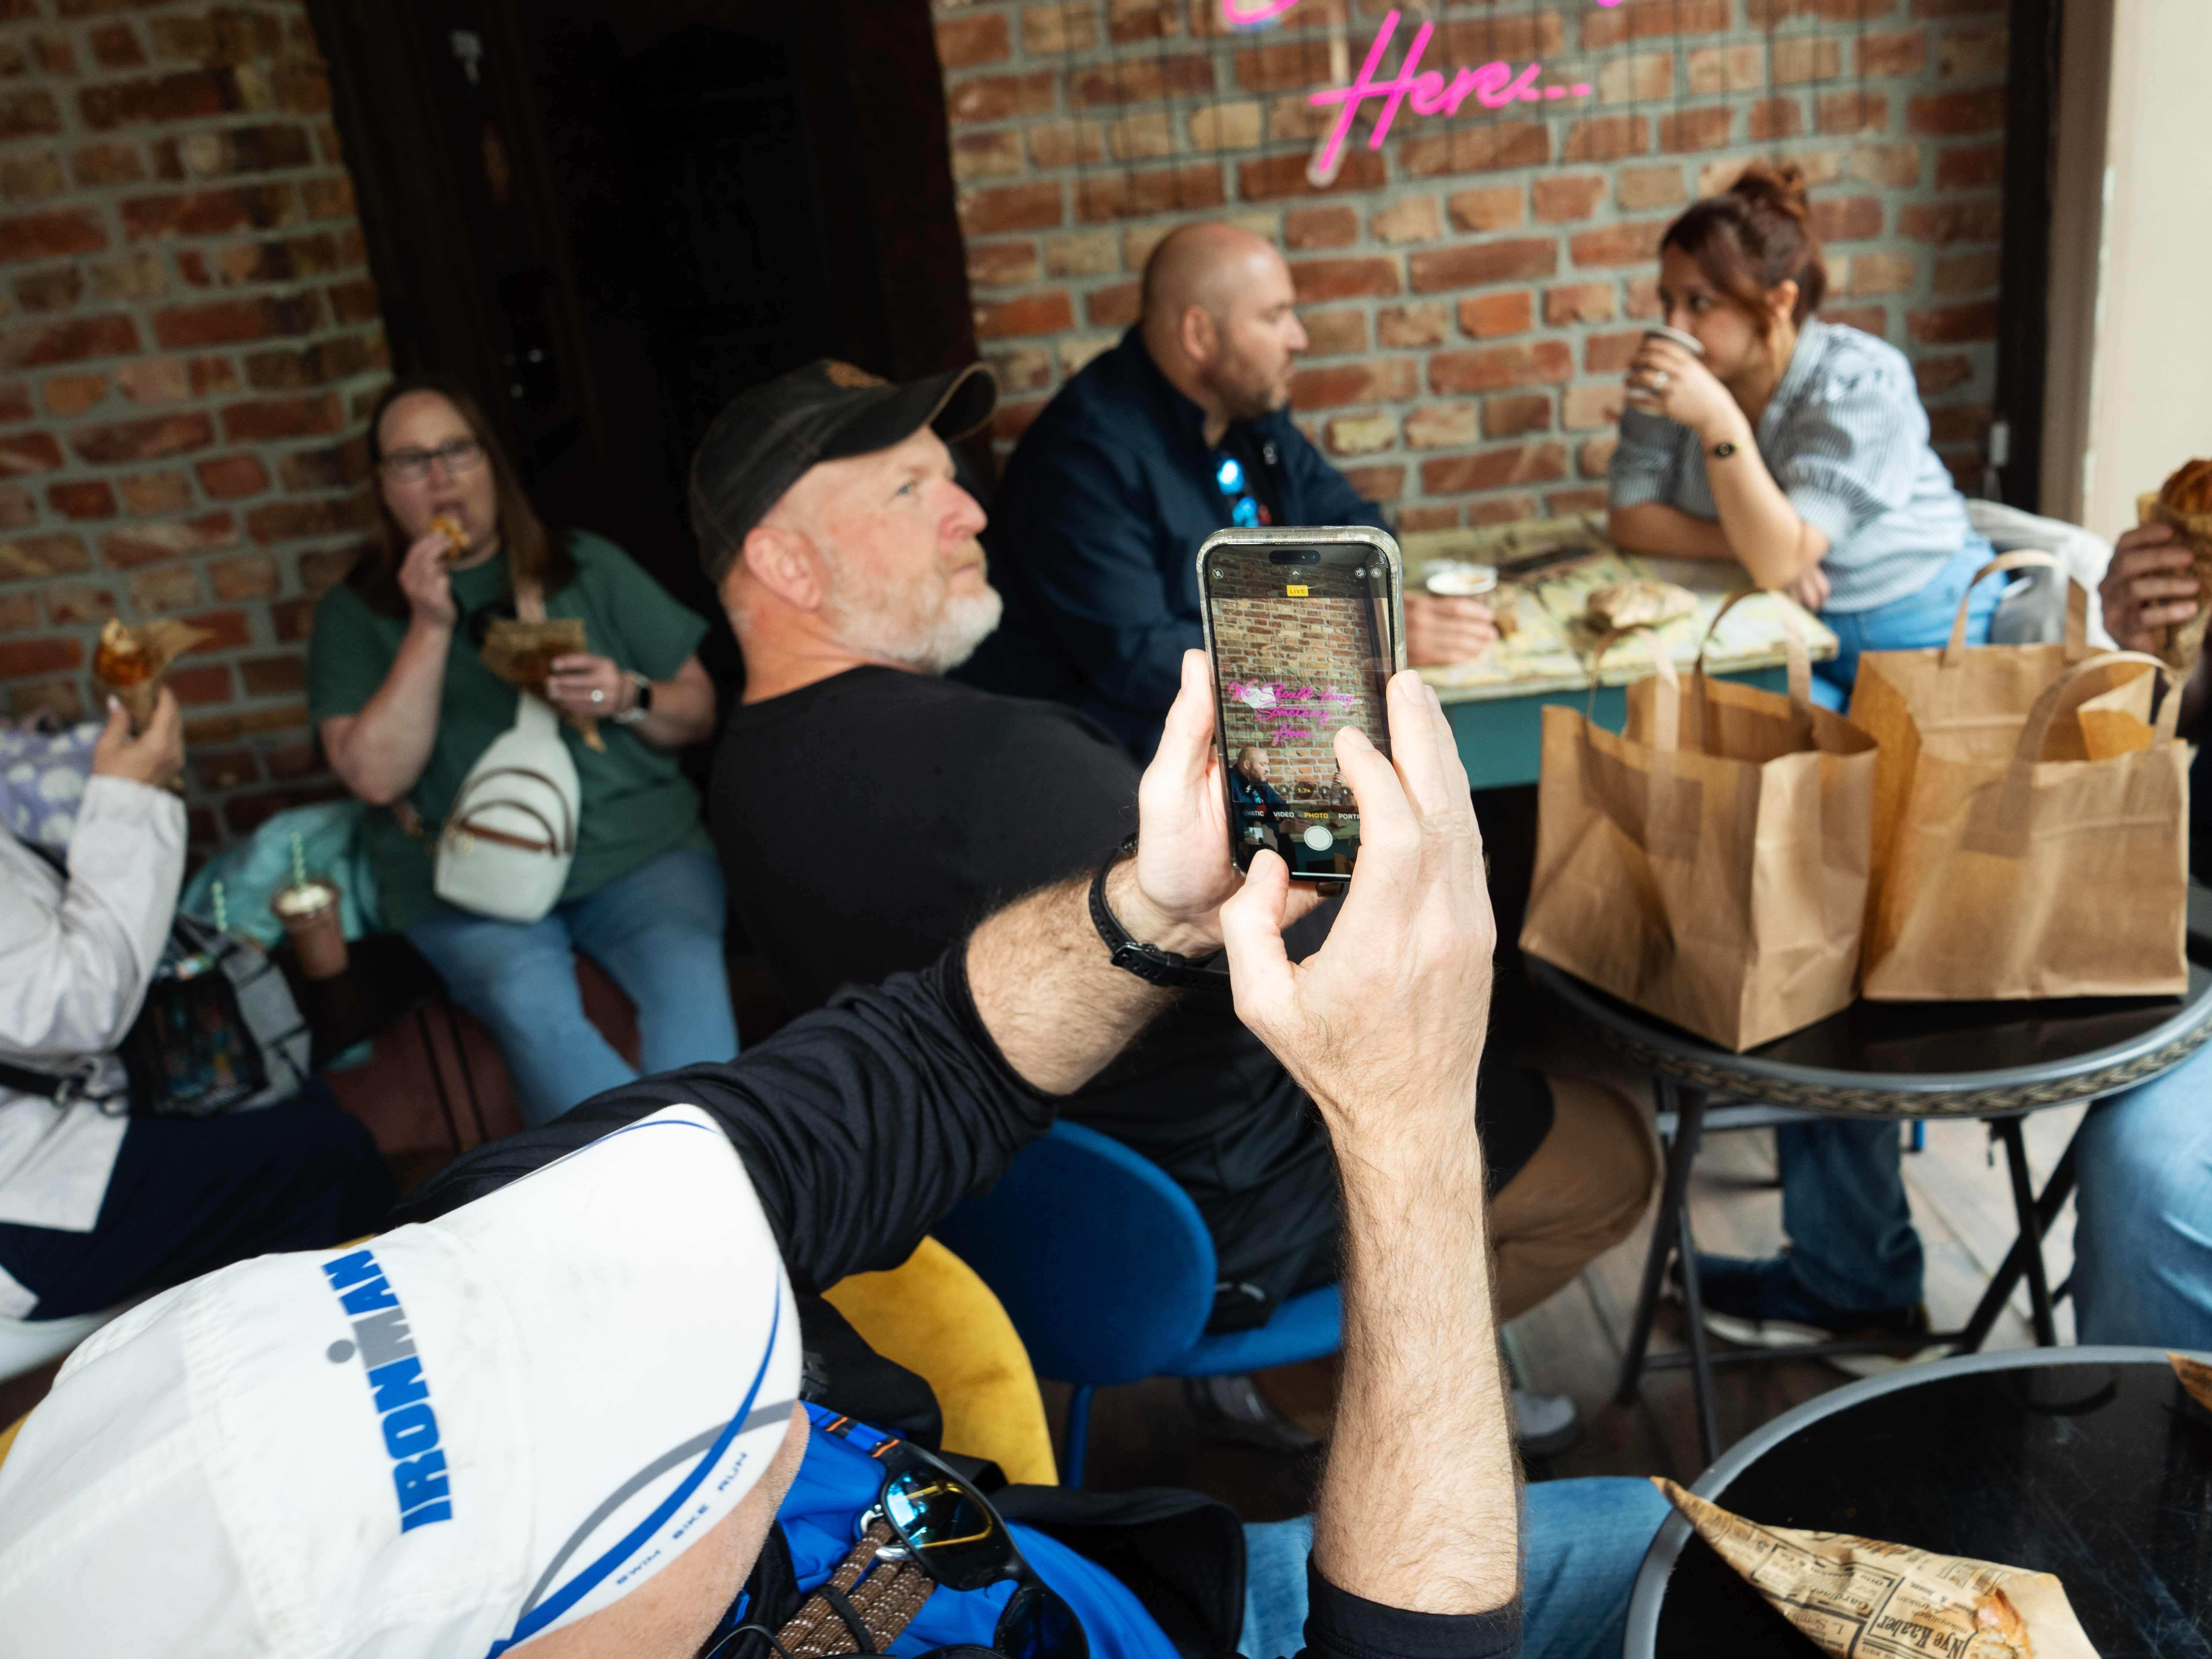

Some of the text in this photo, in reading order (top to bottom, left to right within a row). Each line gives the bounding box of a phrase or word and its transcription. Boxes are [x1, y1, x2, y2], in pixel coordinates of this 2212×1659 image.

[1228, 679, 1259, 701] We
[1259, 682, 1314, 702] Should
[1256, 701, 1349, 726] Something
[321, 1249, 453, 1535] IRONMAN
[616, 1451, 748, 1585] SWIM BIKE RUN
[1877, 1615, 1935, 1649] Kaaber
[1933, 1632, 1965, 1659] Nye
